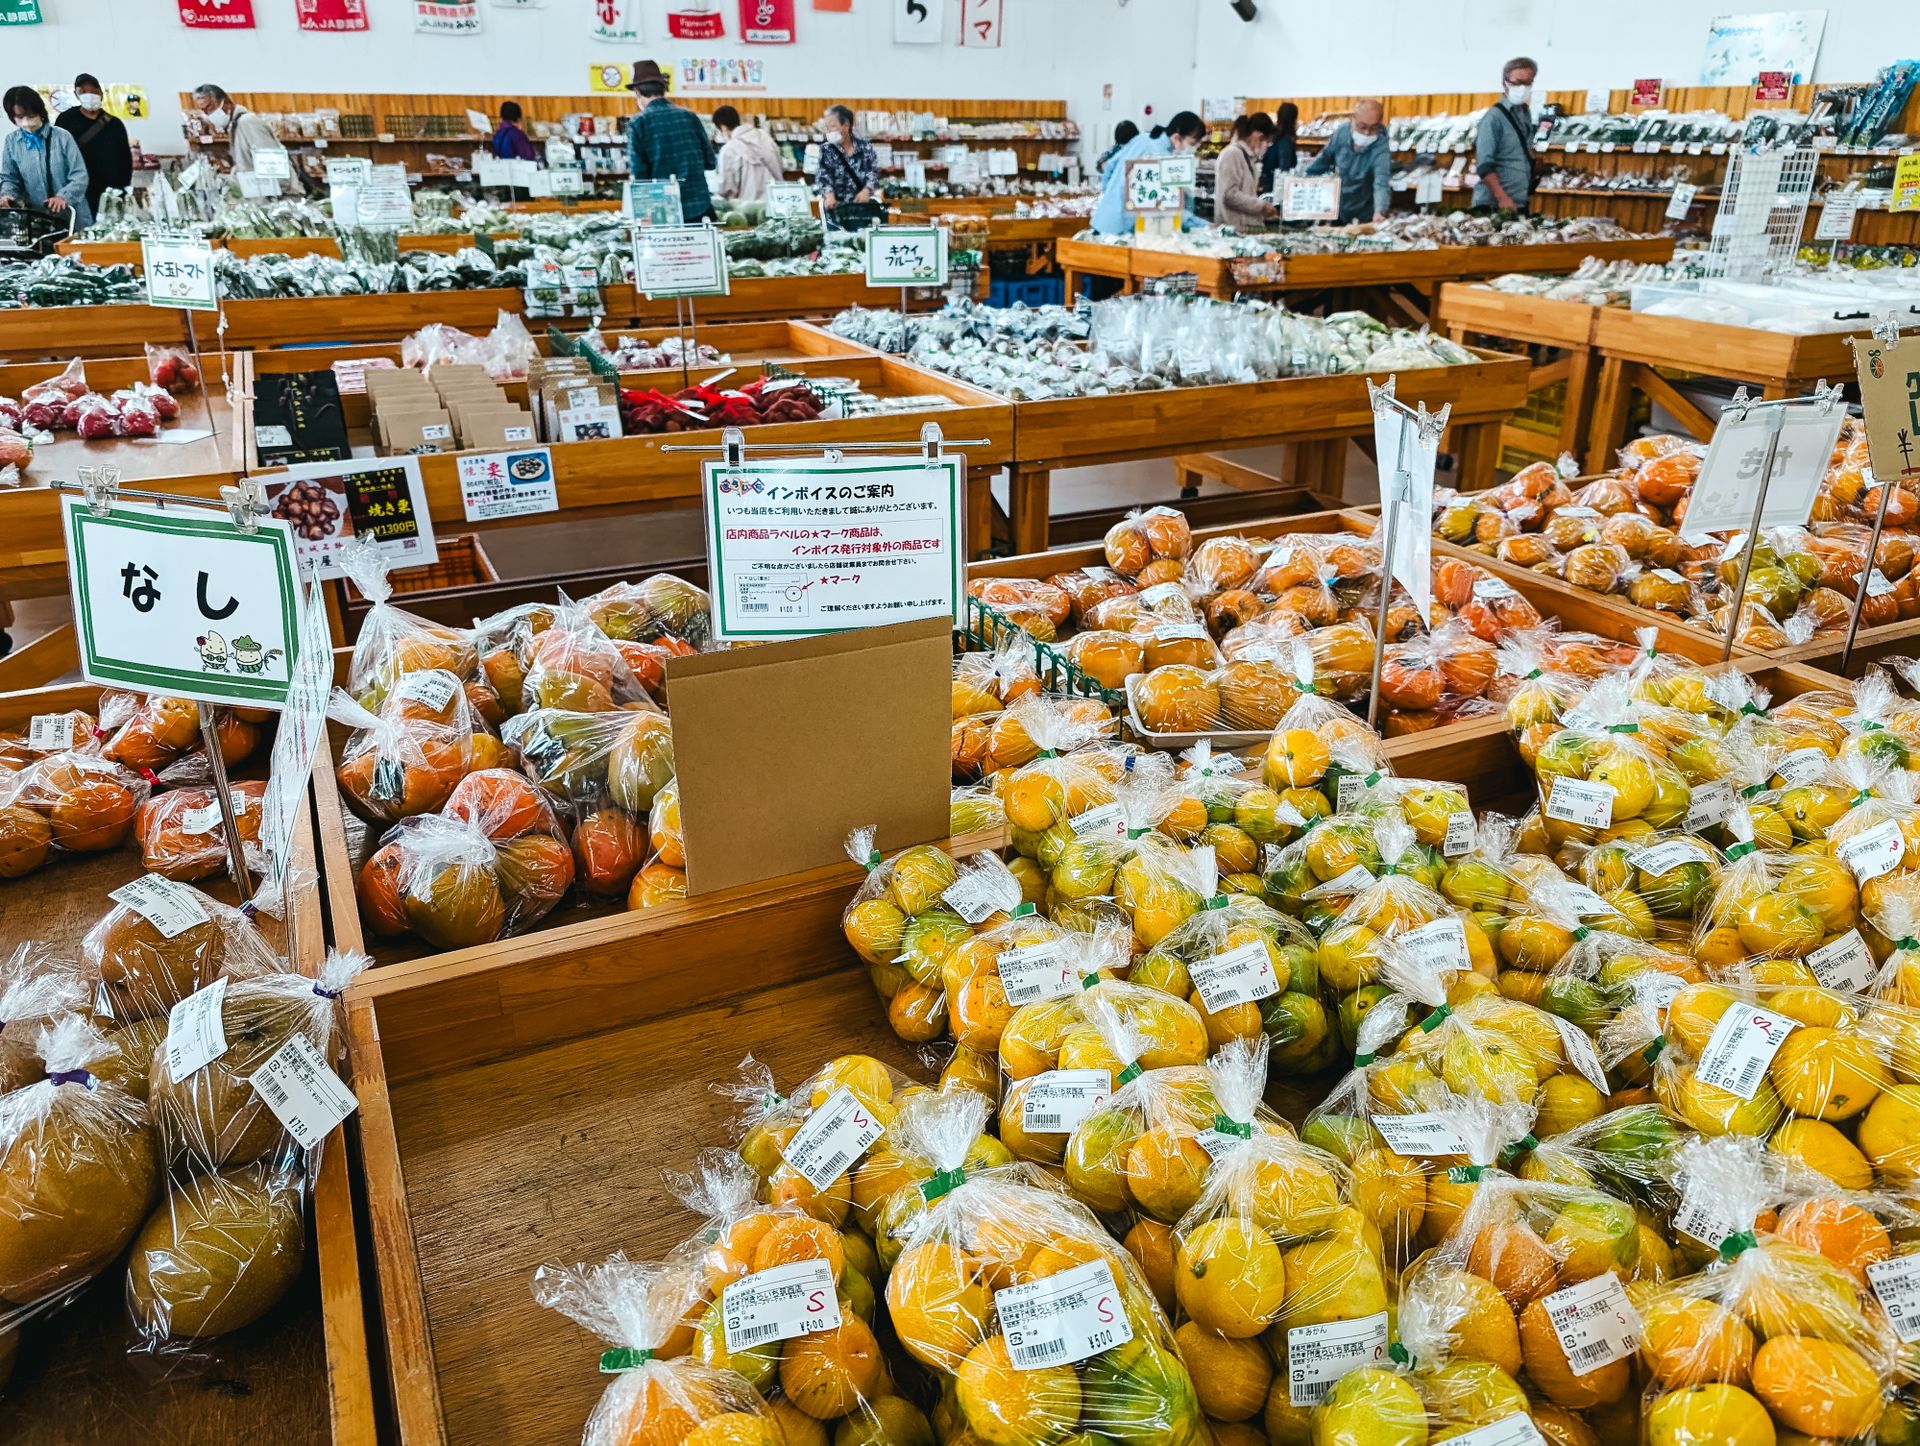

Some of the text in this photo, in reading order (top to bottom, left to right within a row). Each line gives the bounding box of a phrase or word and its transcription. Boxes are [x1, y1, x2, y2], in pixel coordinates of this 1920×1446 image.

[889, 244, 920, 256] キウイ
[152, 260, 205, 279] 大玉トマト
[884, 255, 924, 268] フルーツ
[767, 484, 894, 500] インボイスのご案内
[727, 502, 938, 515] いつも当店をご利用いただきまして誠にありがとうございます。
[792, 539, 940, 555] インボイス発行対象外の商品です
[820, 600, 946, 612] ご理解くださいますようお願い申し上げます。
[146, 912, 169, 926] ¥500
[1250, 984, 1268, 997] ¥500
[1765, 1028, 1785, 1046] ¥500
[170, 1046, 181, 1069] ¥750
[287, 1114, 308, 1137] ¥750
[849, 1109, 870, 1130] S
[855, 1129, 874, 1148] ¥500
[739, 1274, 761, 1286] みかん
[1014, 1281, 1038, 1296] みかん
[804, 1289, 827, 1314] S
[1093, 1295, 1116, 1325] S
[799, 1317, 824, 1333] ¥500
[1305, 1325, 1327, 1337] みかん
[1086, 1329, 1114, 1349] ¥500
